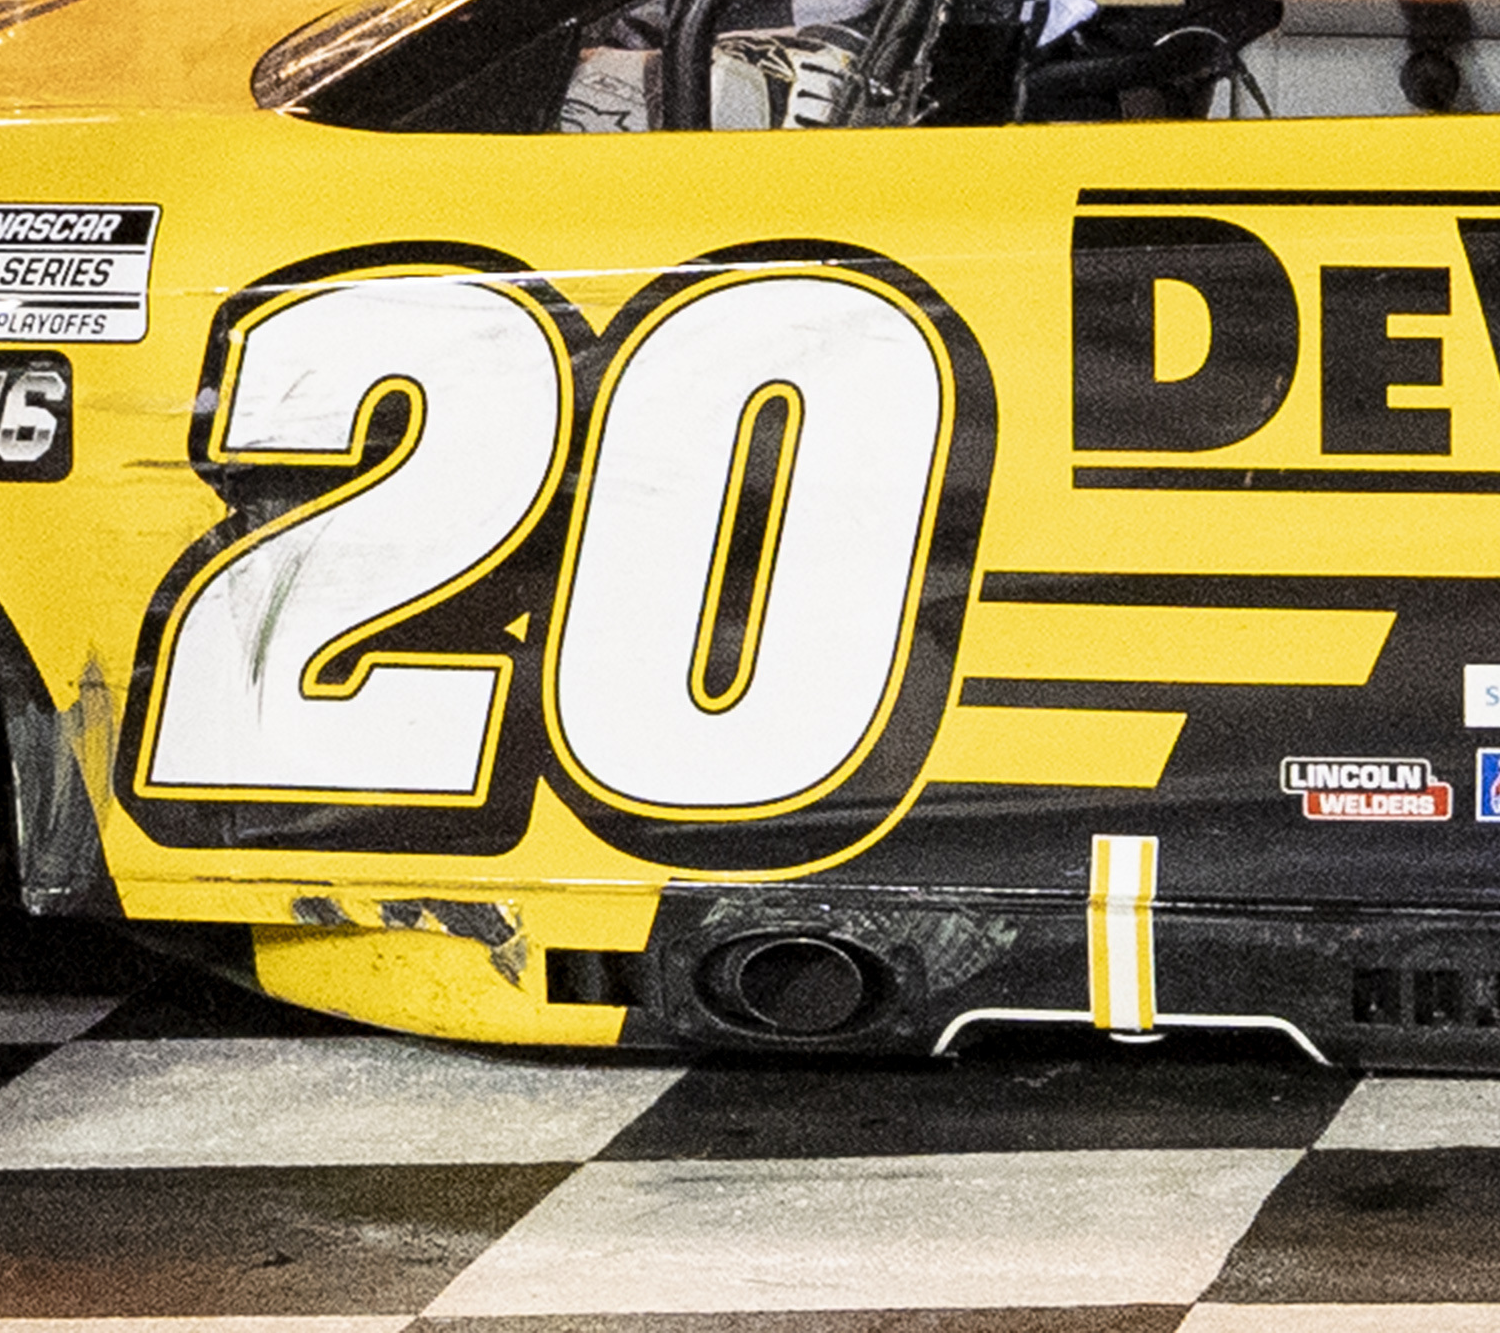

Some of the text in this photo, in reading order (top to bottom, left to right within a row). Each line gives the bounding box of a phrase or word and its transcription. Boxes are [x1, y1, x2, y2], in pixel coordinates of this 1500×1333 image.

[2, 258, 114, 287] SERIES
[140, 255, 968, 843] 20
[1289, 762, 1421, 790] LINCOLN
[1319, 792, 1435, 817] WELDERS
